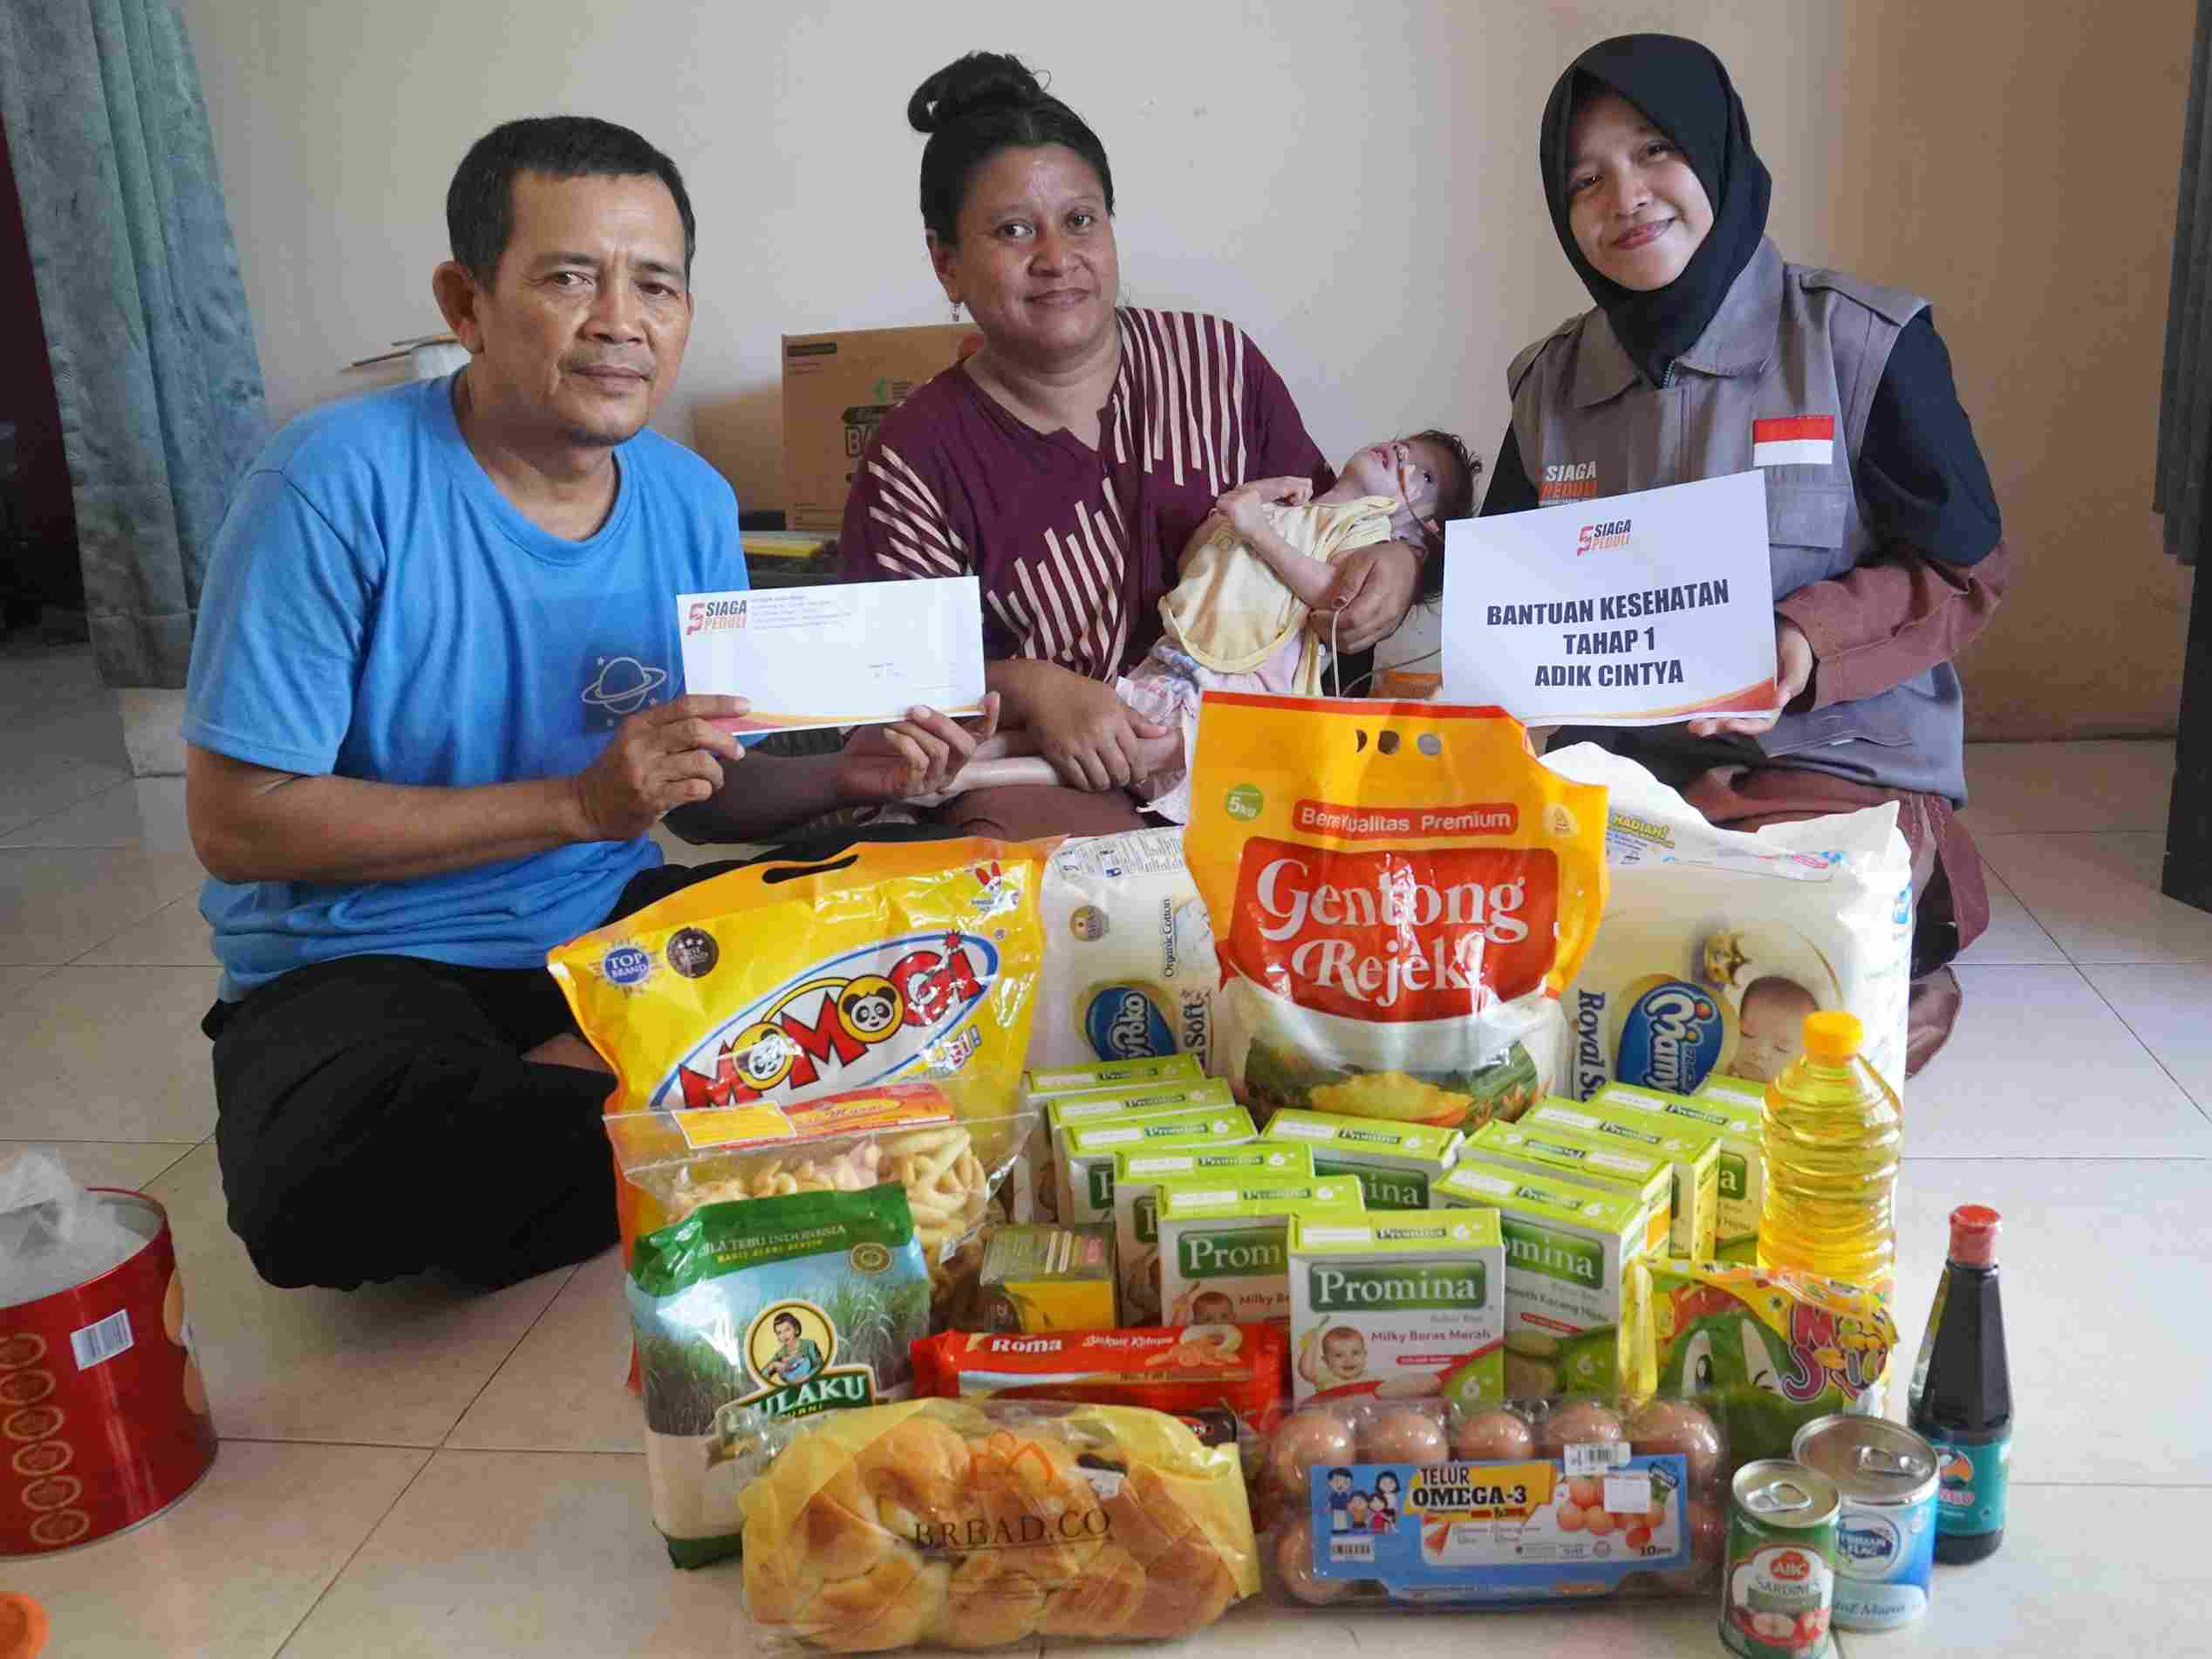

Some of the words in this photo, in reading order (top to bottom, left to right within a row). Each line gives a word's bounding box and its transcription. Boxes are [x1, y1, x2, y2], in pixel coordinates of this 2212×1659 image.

[1545, 461, 1597, 481] SIAGA
[1594, 519, 1632, 537] SIAGA
[706, 600, 748, 617] SIAGA
[1486, 597, 1594, 626] BANTUAN
[1600, 578, 1730, 621] KESEHATAN
[1563, 629, 1638, 655] TAHAP
[1644, 626, 1656, 652] 1
[1534, 665, 1592, 686] ADIK
[1598, 659, 1684, 686] CINTYA
[1422, 811, 1512, 831] Premium
[1257, 857, 1528, 945] Gentong
[1162, 898, 1173, 934] Cotton
[607, 952, 643, 969] TOP
[1164, 936, 1176, 977] Organic
[1183, 1004, 1206, 1048] Soft
[1577, 990, 1606, 1068] Royal
[1187, 1239, 1282, 1270] Prom
[1506, 1234, 1594, 1280] mina
[1319, 1269, 1479, 1304] Promina
[1370, 1331, 1406, 1344] Milky
[757, 1376, 866, 1417] ULAKU
[1420, 1465, 1470, 1485] TELUR
[1412, 1485, 1526, 1507] OMEGA-3
[1640, 1545, 1656, 1557] 10
